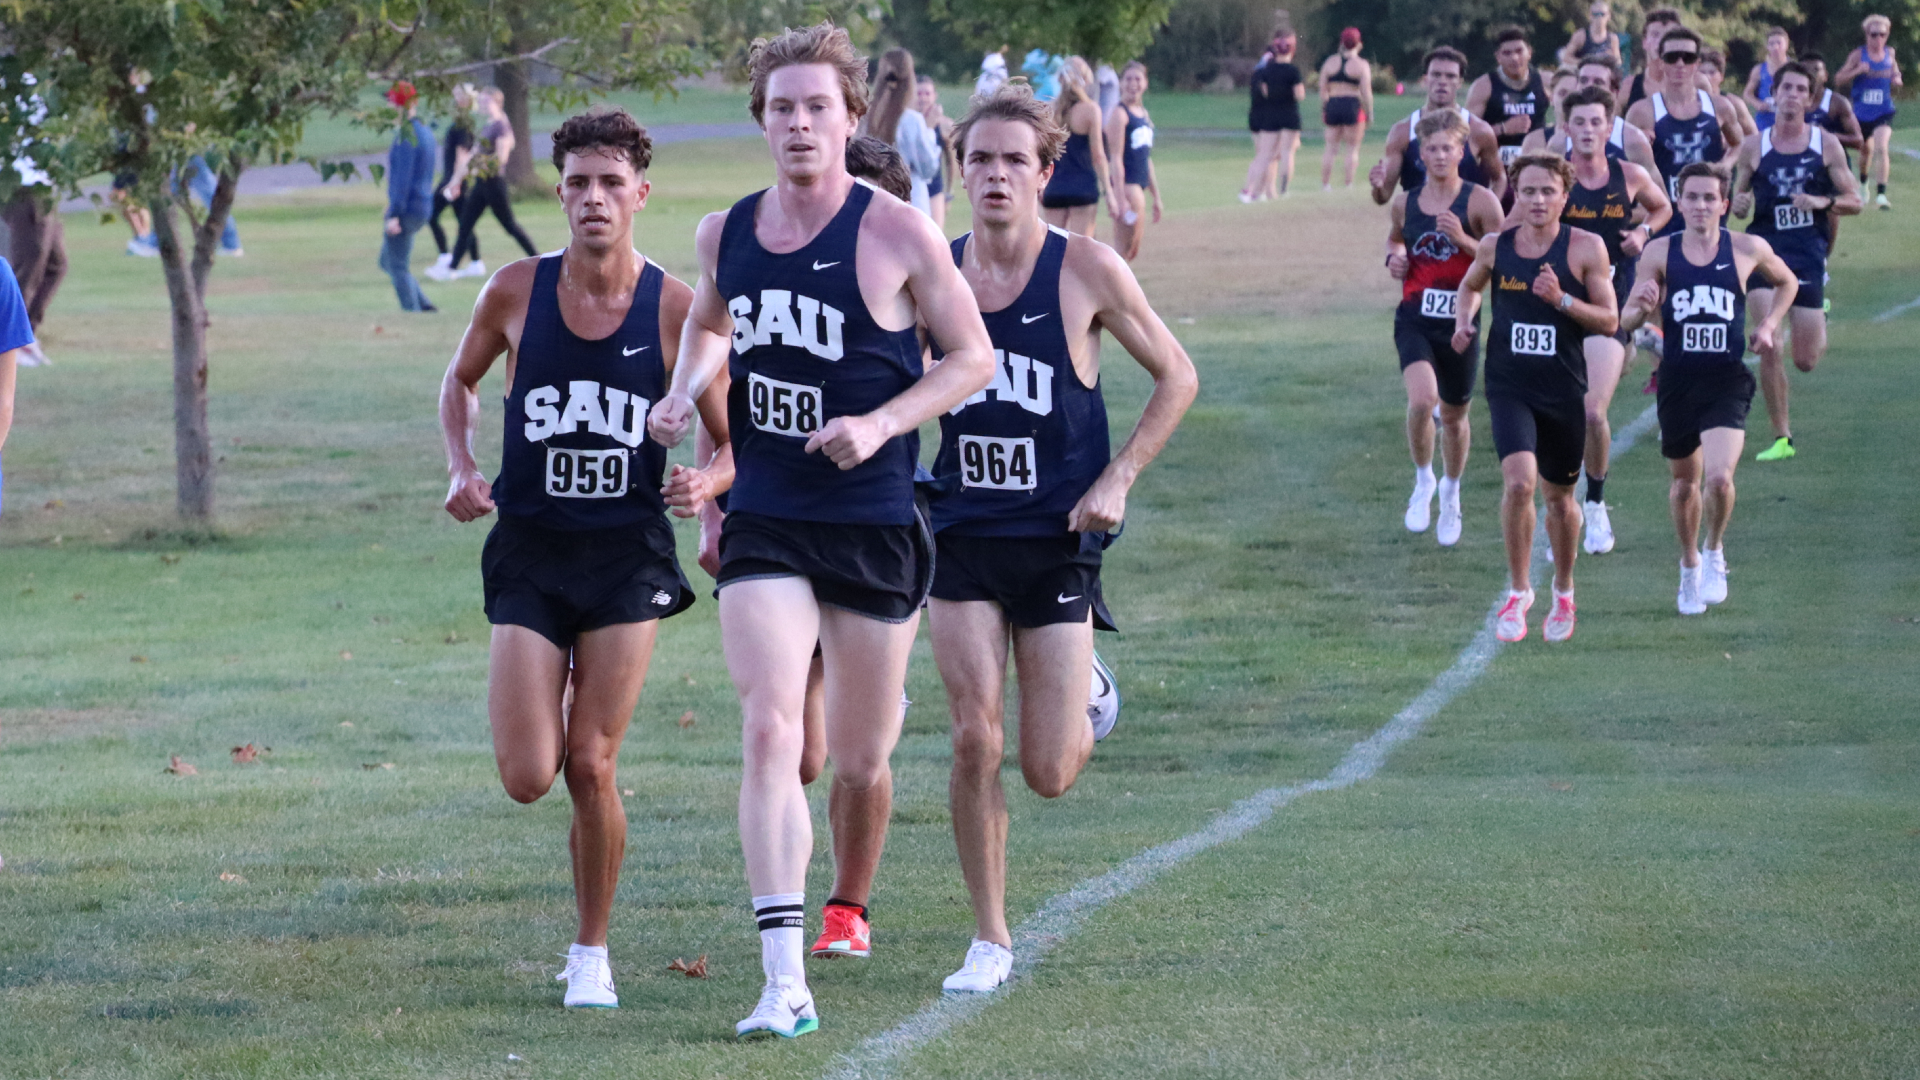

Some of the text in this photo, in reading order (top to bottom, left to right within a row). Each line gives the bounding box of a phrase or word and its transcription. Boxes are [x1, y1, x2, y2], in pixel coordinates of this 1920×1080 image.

[1503, 102, 1535, 115] FAITH
[1566, 203, 1625, 218] Indian Hills
[1778, 204, 1810, 227] 881
[1672, 285, 1736, 322] SAU
[728, 289, 845, 362] SAU
[1514, 326, 1553, 352] 893
[1686, 327, 1723, 349] 960
[949, 349, 1054, 416] AU
[524, 380, 650, 448] SAU
[752, 381, 818, 433] 958
[551, 452, 623, 494] 959
[964, 441, 1032, 485] 964
